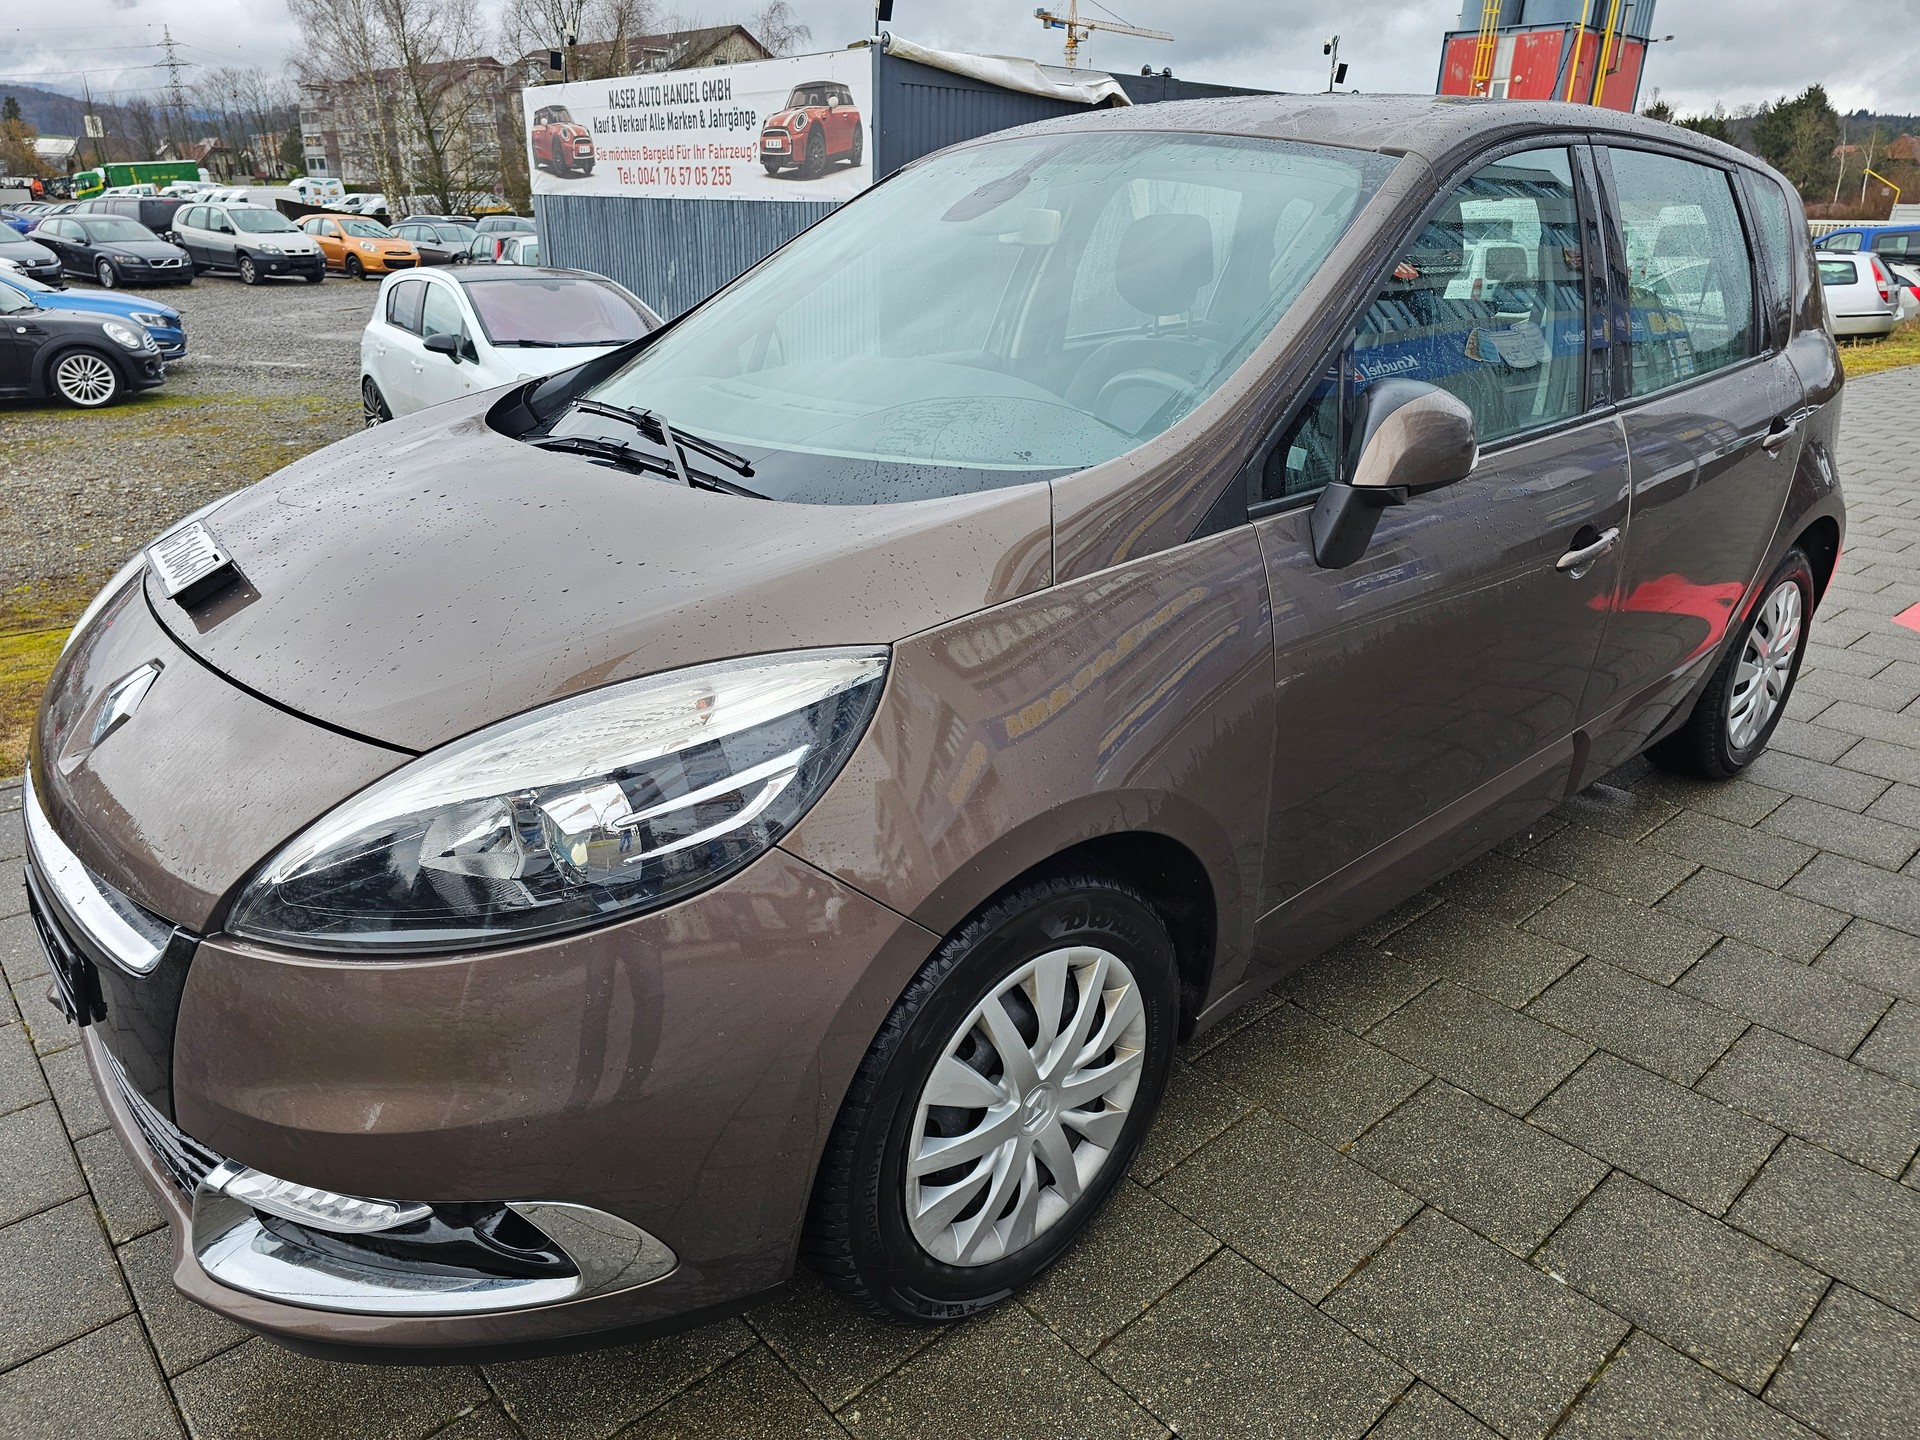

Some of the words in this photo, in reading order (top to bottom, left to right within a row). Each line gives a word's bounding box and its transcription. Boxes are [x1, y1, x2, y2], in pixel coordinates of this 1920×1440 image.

[608, 88, 637, 110] NASER
[638, 85, 661, 108] AUTO
[663, 81, 700, 106] HANDEL
[702, 78, 731, 102] GMBH
[593, 115, 610, 134] Kauf
[611, 115, 617, 133] &
[617, 113, 647, 133] Verkauf
[649, 112, 666, 131] Alle
[667, 110, 698, 131] Marken
[699, 109, 707, 129] &
[708, 106, 757, 132] Jahrgänge
[596, 147, 608, 161] Sie
[608, 146, 642, 161] möchten
[642, 145, 675, 164] Bargeld
[676, 144, 692, 160] Für
[693, 143, 707, 160] Ihr
[708, 142, 758, 163] Fahrzeug?
[617, 166, 636, 185] Tel:
[637, 166, 661, 185] 0041
[663, 166, 677, 185] 76
[679, 166, 692, 186] 57
[694, 166, 708, 186] 05
[711, 165, 732, 186] 255
